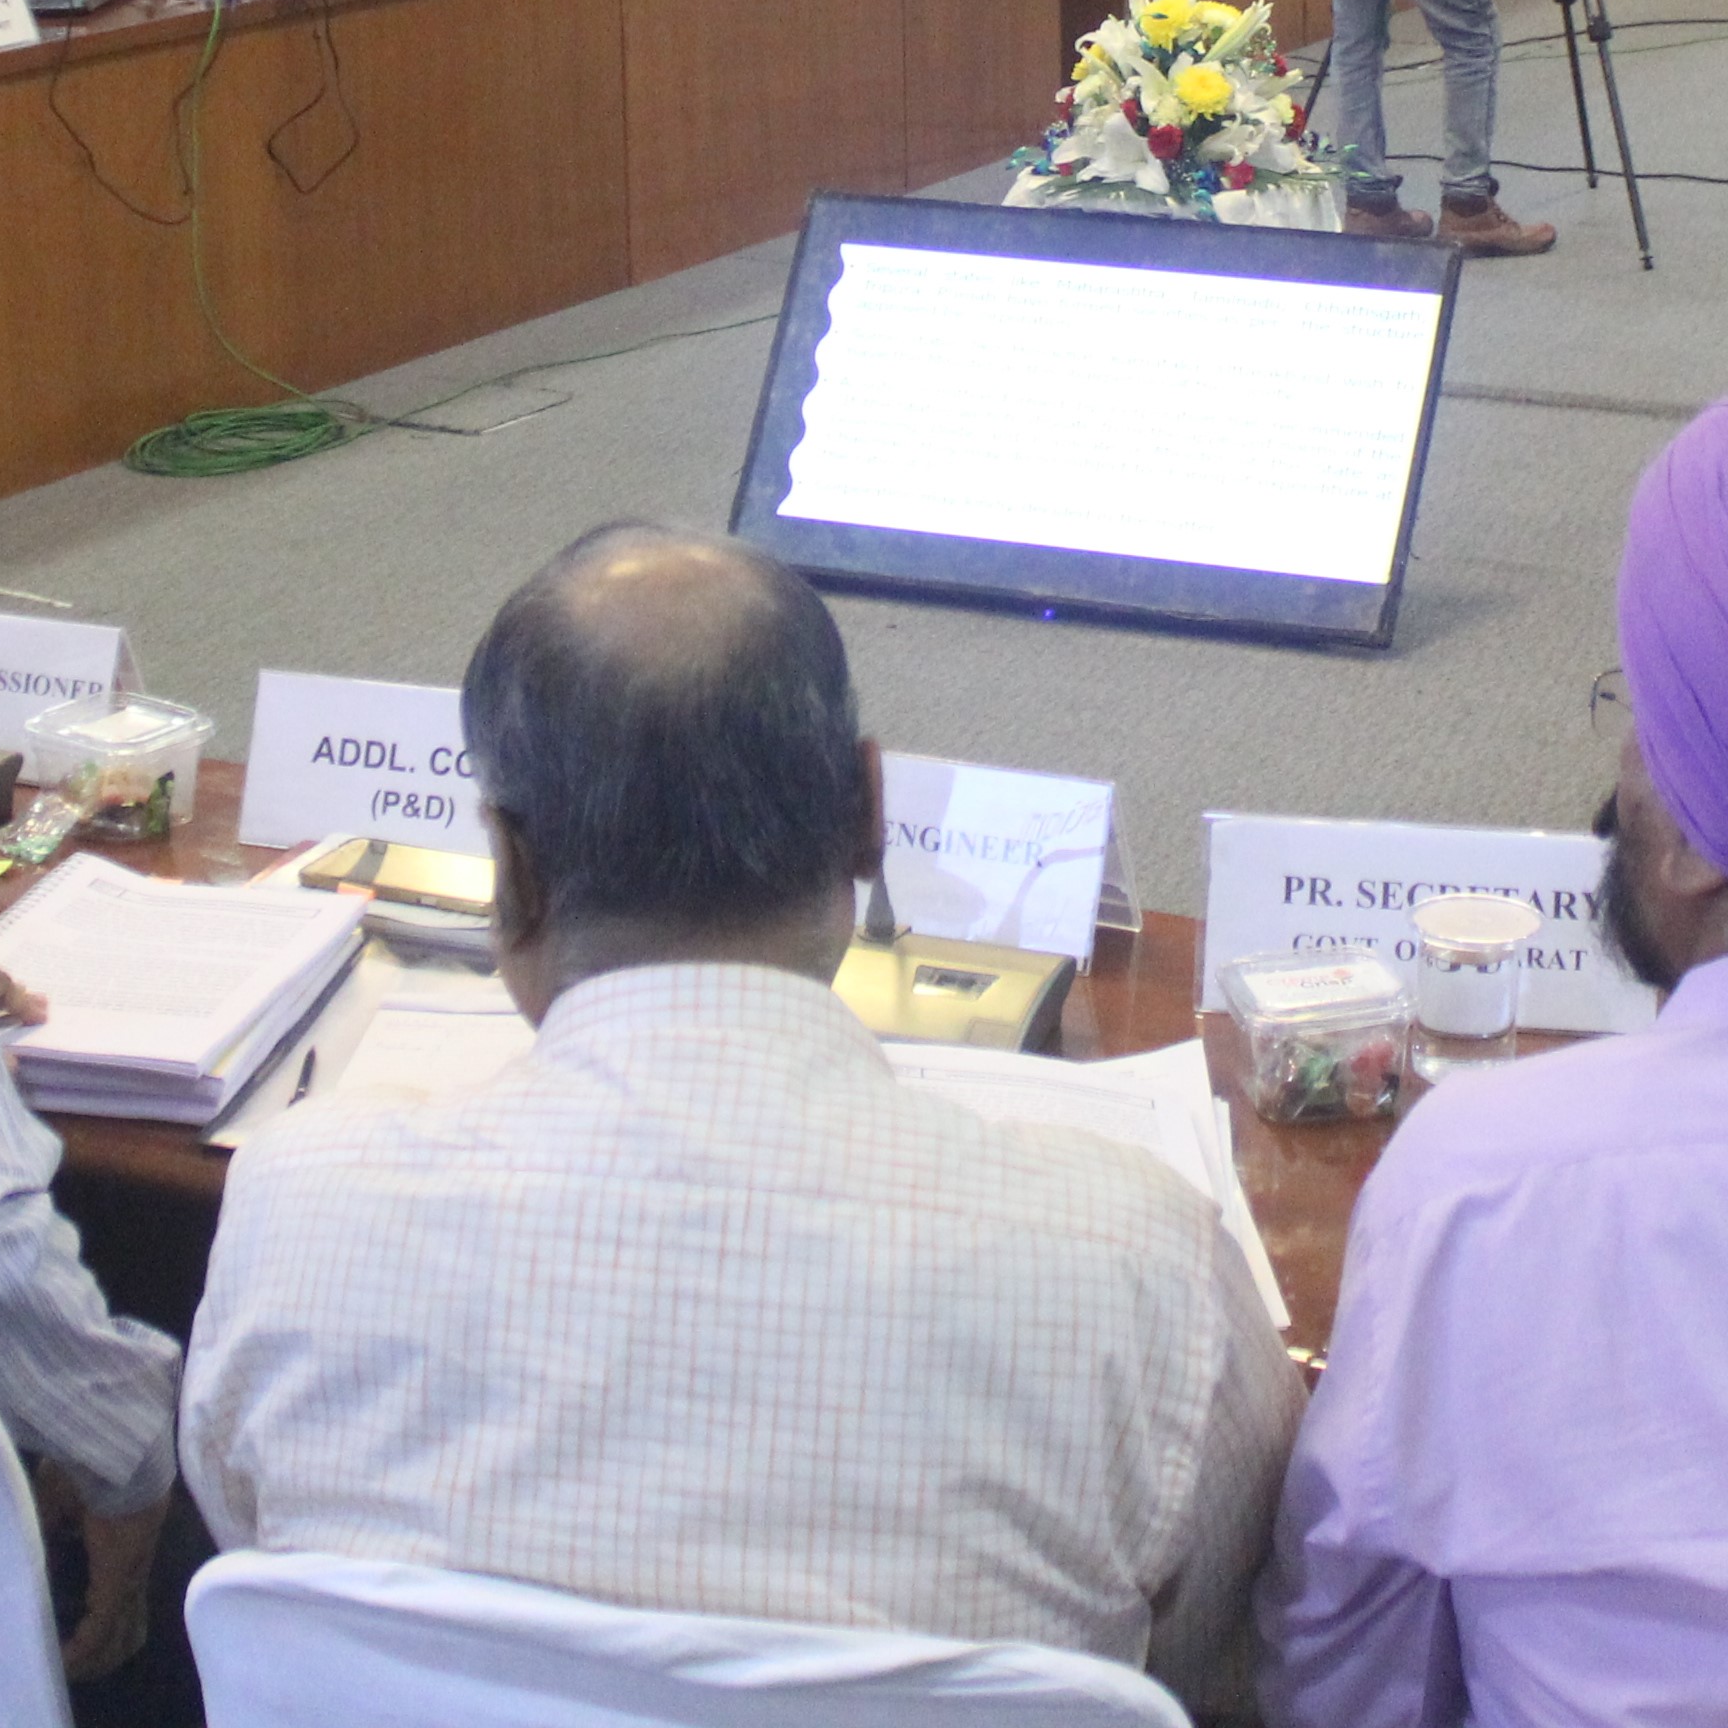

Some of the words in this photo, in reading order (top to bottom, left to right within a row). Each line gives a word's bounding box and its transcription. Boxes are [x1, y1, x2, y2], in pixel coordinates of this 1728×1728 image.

[311, 736, 416, 774] ADDL.
[371, 788, 455, 829] (P&D)
[1282, 874, 1344, 908] PR.
